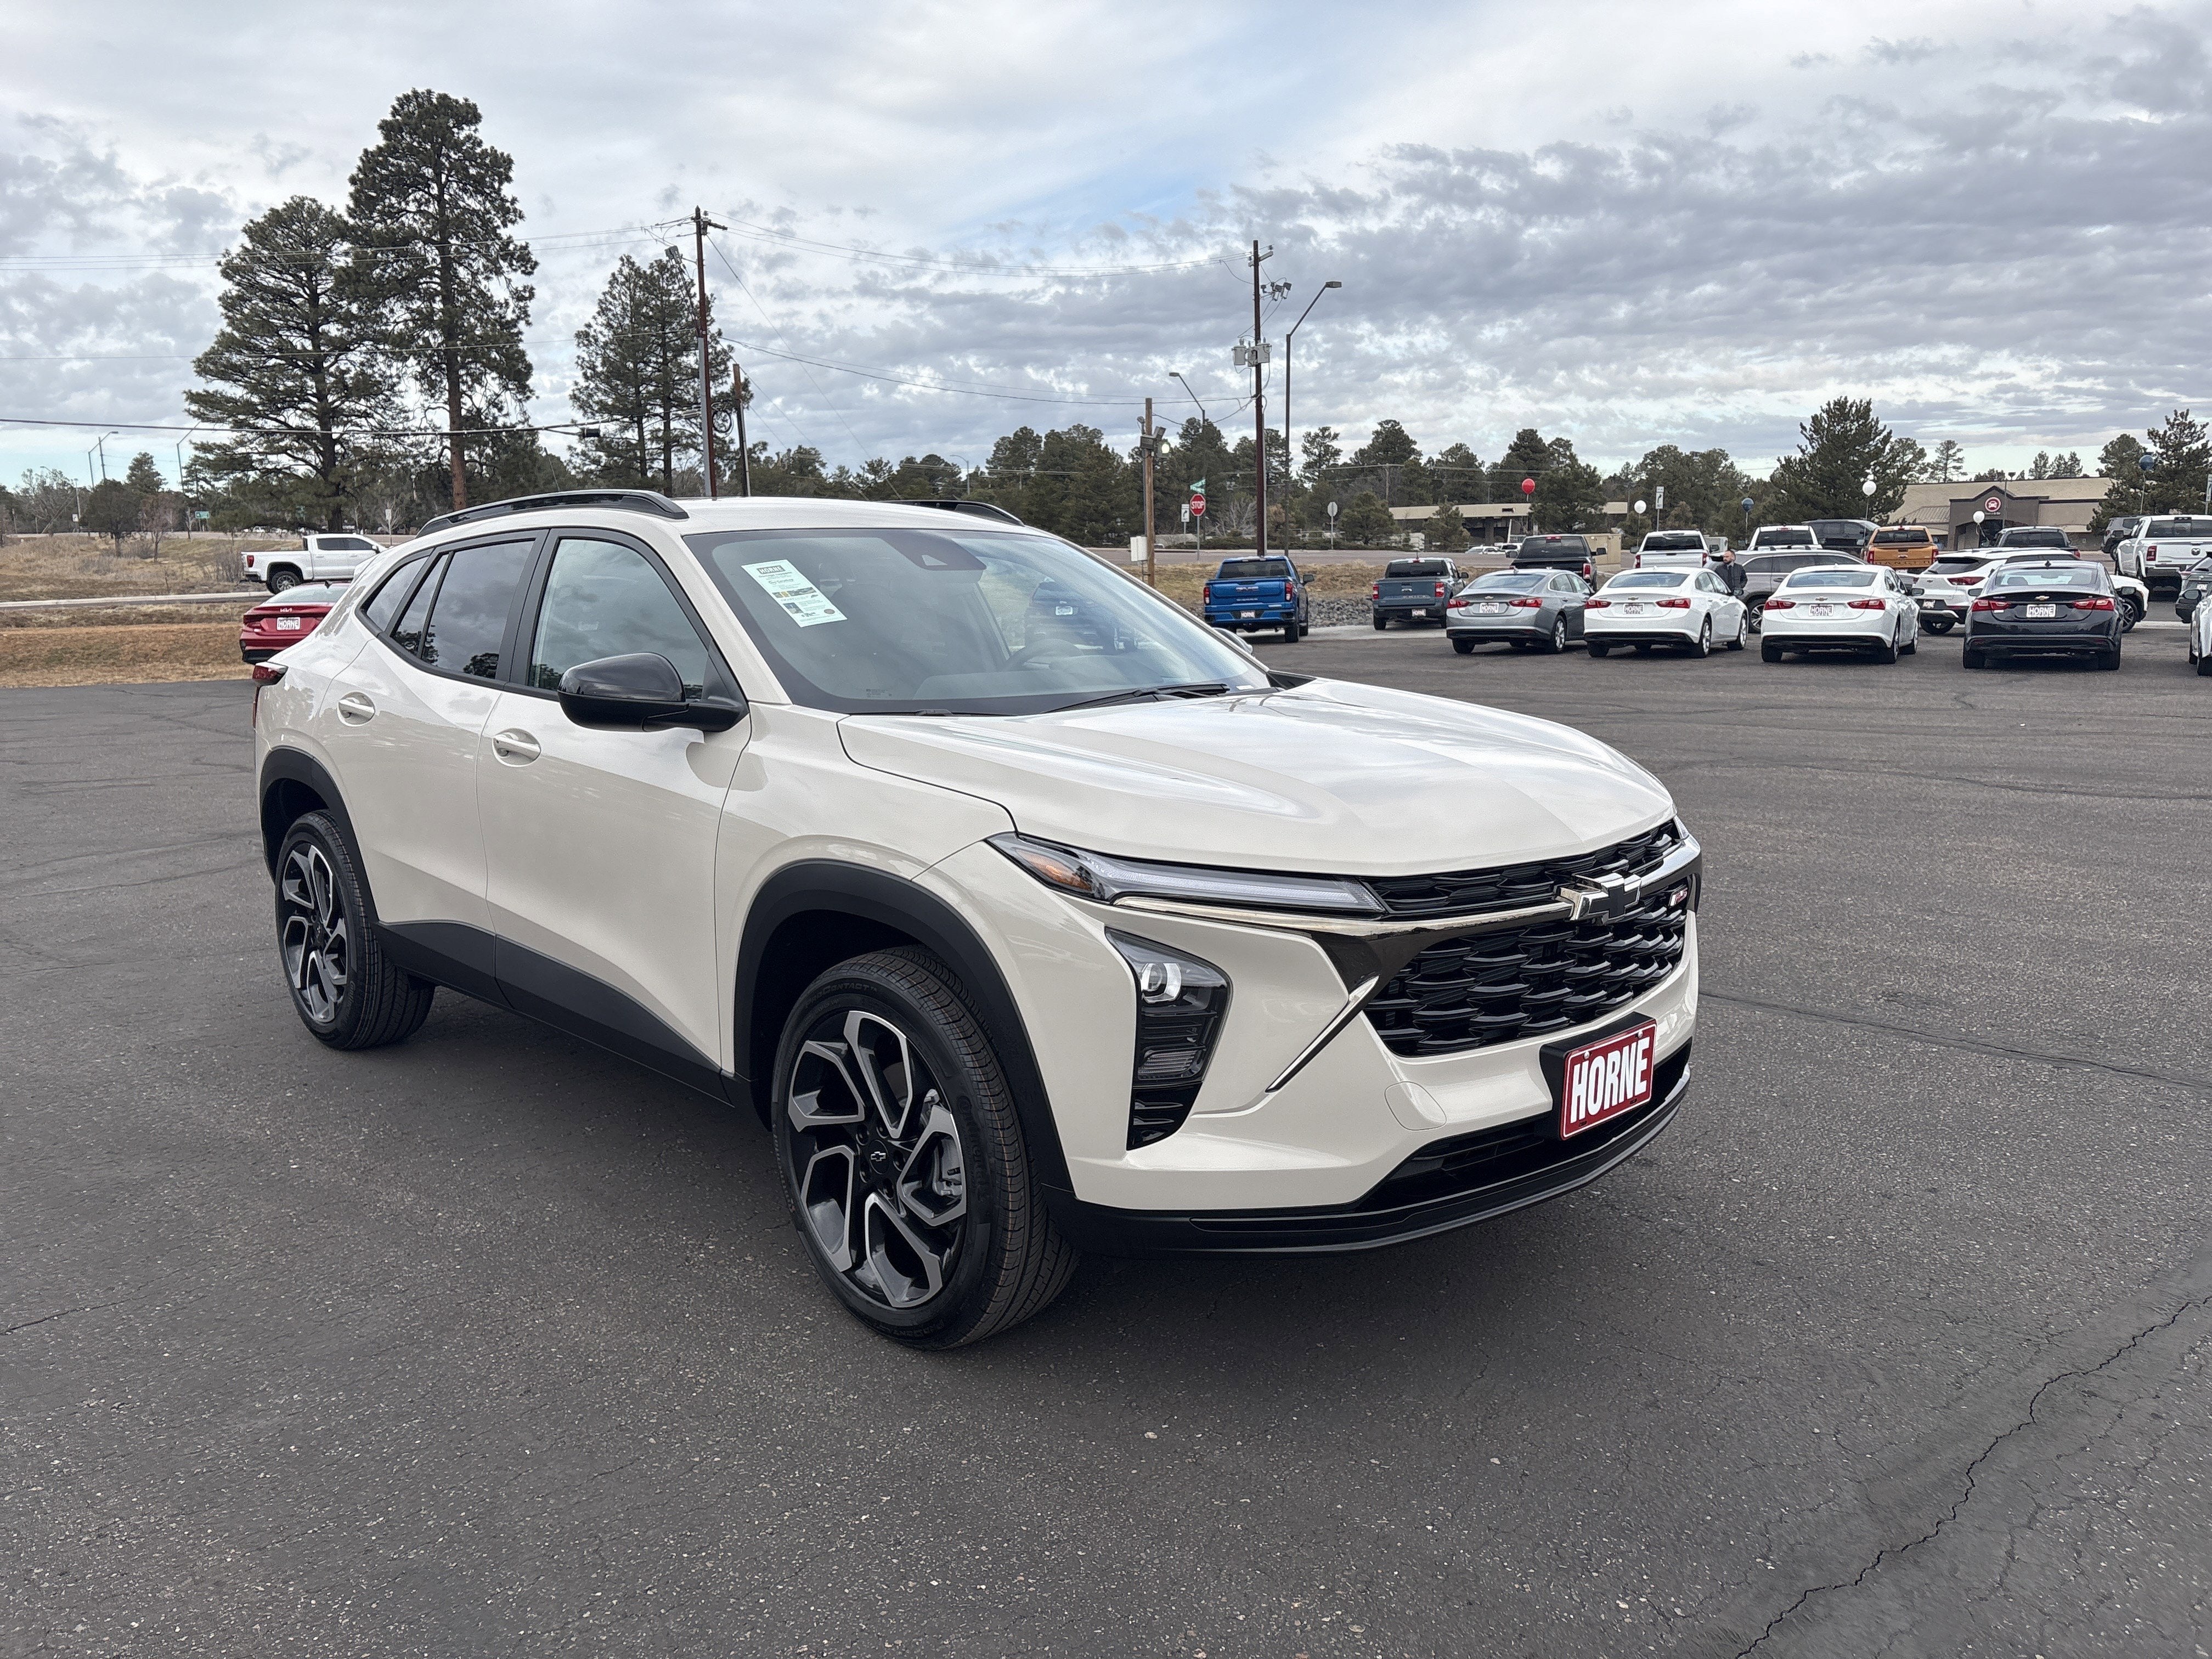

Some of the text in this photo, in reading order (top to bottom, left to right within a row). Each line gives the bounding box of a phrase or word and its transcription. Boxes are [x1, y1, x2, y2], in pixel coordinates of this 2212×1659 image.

[1192, 501, 1204, 509] STOP
[279, 619, 298, 628] HORNE
[1570, 1036, 1650, 1124] HORNE
